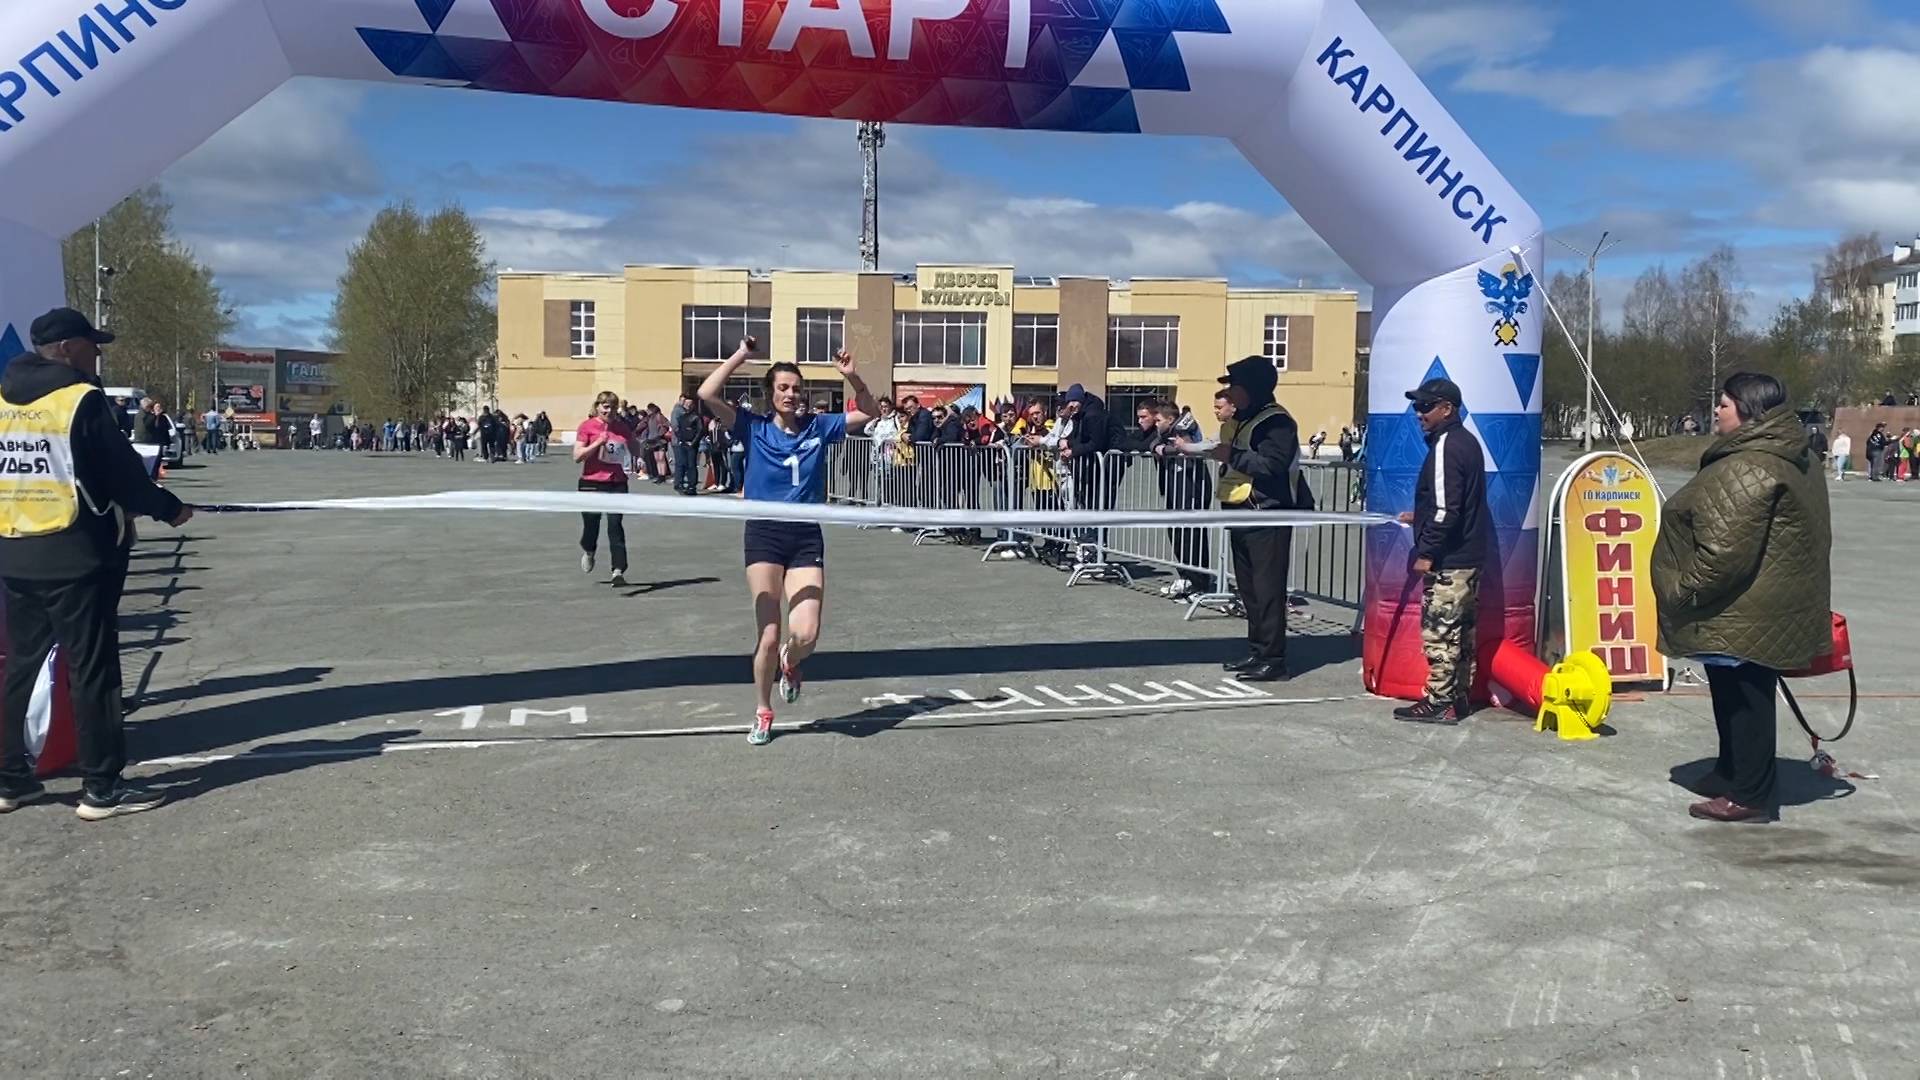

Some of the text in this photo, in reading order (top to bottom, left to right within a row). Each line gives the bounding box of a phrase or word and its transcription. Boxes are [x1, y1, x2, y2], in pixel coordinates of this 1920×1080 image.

[0, 0, 187, 132] РПИН
[1316, 36, 1508, 244] КАРПИНСК
[934, 272, 999, 289] ДВОРЕЦ
[921, 289, 1010, 306] КУЛЬТУРЫ
[291, 363, 329, 377] ГАЛ
[783, 455, 799, 486] 1
[1584, 508, 1648, 675] ФИНИШ
